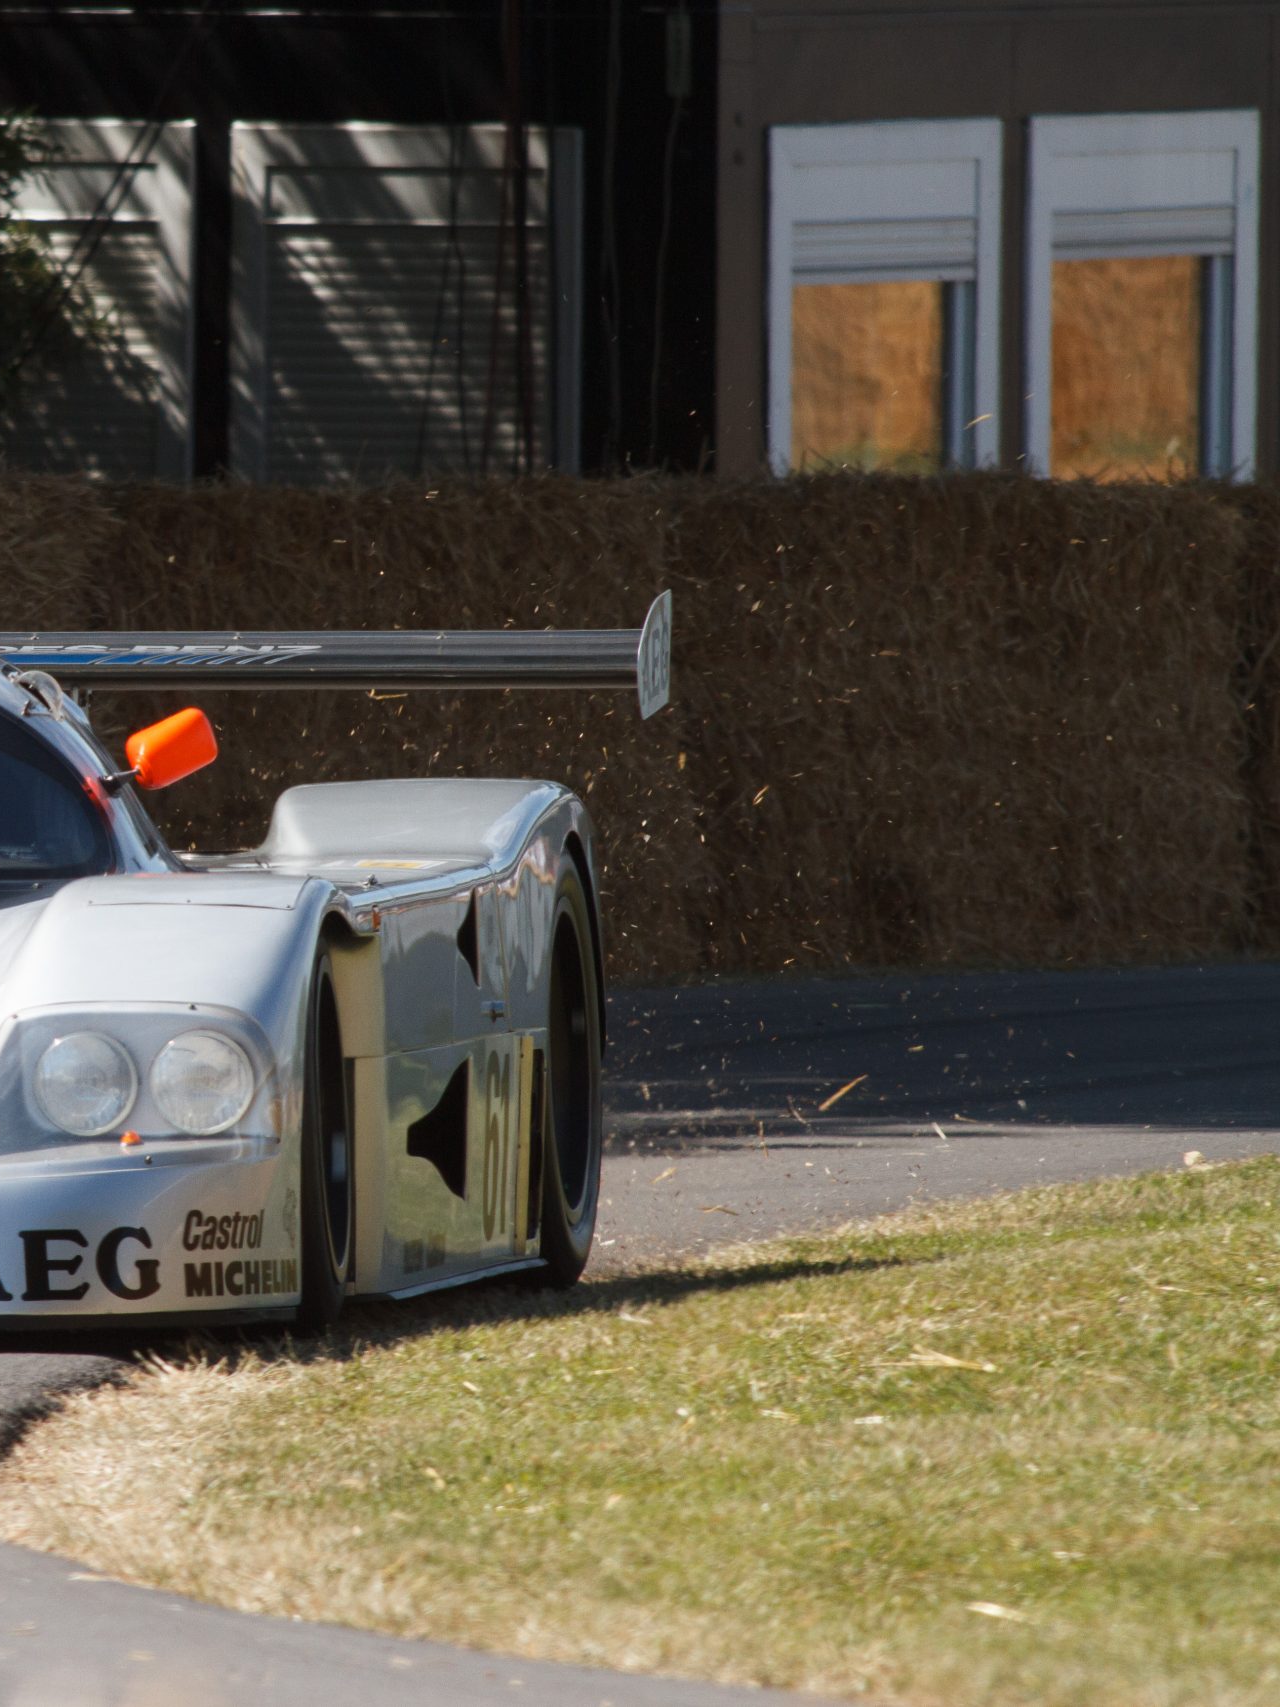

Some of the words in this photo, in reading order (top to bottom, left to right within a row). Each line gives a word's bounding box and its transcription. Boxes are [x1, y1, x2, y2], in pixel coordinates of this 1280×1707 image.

[482, 1049, 510, 1242] 61
[182, 1208, 265, 1252] Castrol
[184, 1258, 298, 1298] MICHELIN
